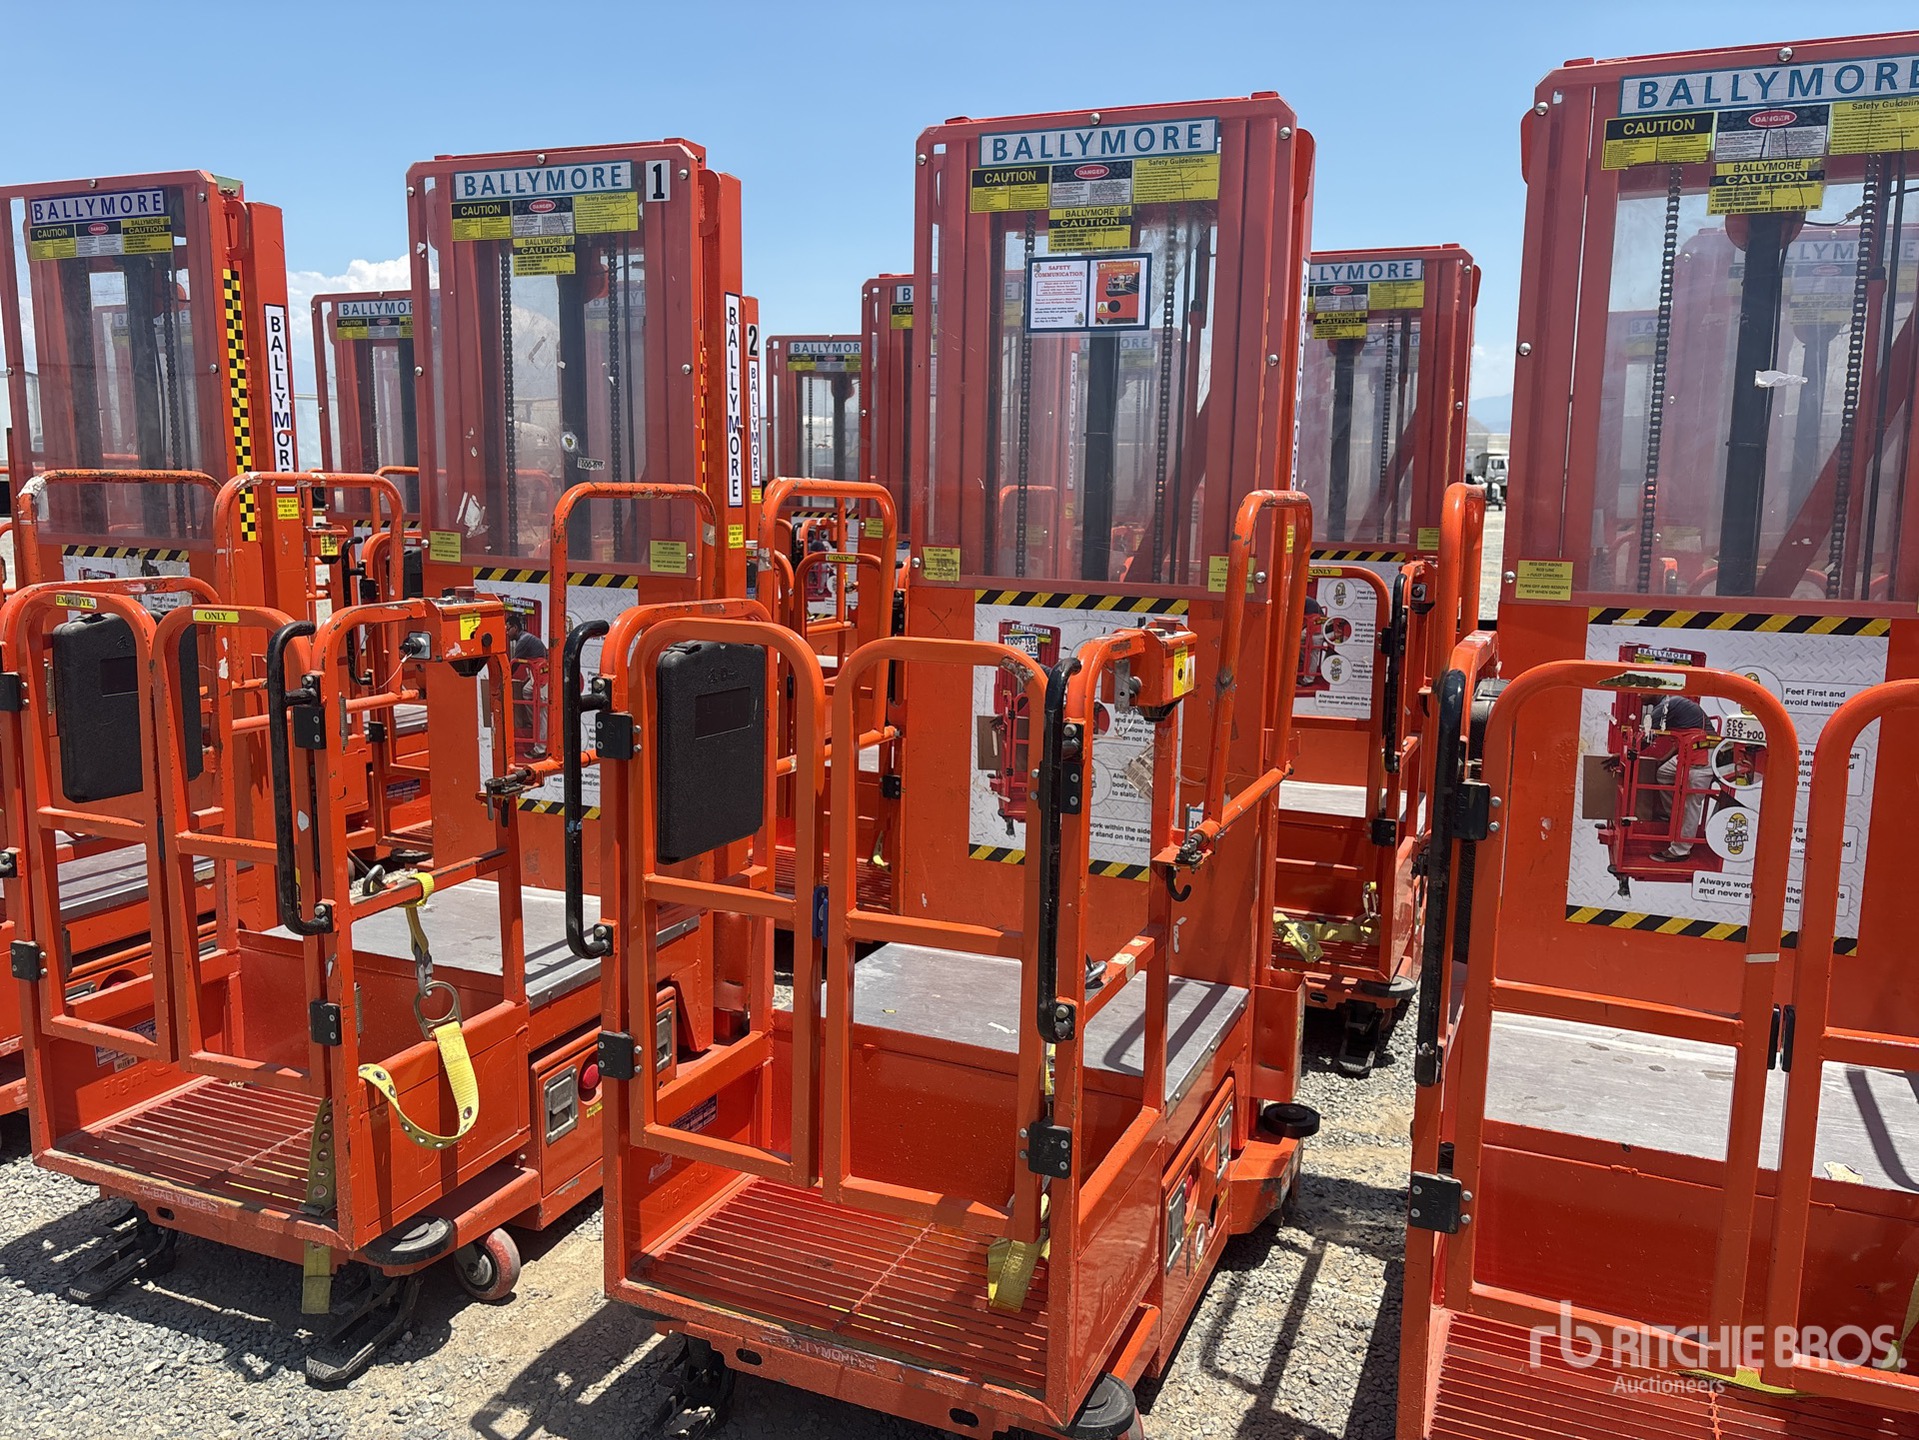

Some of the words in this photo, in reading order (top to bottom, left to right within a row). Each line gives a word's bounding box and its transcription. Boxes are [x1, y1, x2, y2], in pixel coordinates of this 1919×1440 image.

[1851, 101, 1880, 110] Safety
[1754, 114, 1791, 123] DANGER
[1623, 118, 1696, 135] CAUTION
[992, 123, 1202, 162] BALLYMORE
[1148, 158, 1168, 167] Safety
[1733, 161, 1802, 173] BALLYMORE
[984, 170, 1037, 184] CAUTION
[1078, 168, 1106, 176] DANGER
[464, 165, 623, 197] BALLYMORE
[652, 163, 665, 200] 1
[1725, 172, 1808, 185] CAUTION
[33, 193, 162, 221] BALLYMORE
[461, 204, 501, 216] CAUTION
[531, 202, 554, 210] DANGER
[1065, 208, 1115, 218] BALLYMORE
[1060, 217, 1120, 228] CAUTION
[37, 228, 68, 239] CAUTION
[128, 226, 165, 235] CAUTION
[524, 237, 563, 246] BALLYMORE
[521, 246, 567, 255] CAUTION
[749, 325, 758, 356] 2
[270, 316, 291, 472] BALLYMOR
[728, 306, 741, 497] BALLYMORE
[750, 368, 759, 482] BALLYMORE
[204, 612, 227, 621] ONLY
[1640, 648, 1689, 660] BALLYMORE
[1785, 688, 1805, 696] Feet
[1806, 688, 1827, 697] First
[1829, 690, 1846, 698] and
[1112, 781, 1127, 789] body
[1120, 790, 1136, 798] static
[1104, 823, 1124, 831] within
[1125, 825, 1136, 833] the
[1137, 826, 1150, 834] side
[1095, 830, 1114, 839] stand
[1124, 833, 1136, 841] the
[1723, 834, 1749, 843] GEAR
[1699, 876, 1732, 887] Always
[1787, 886, 1802, 894] the
[1717, 890, 1741, 898] never
[1785, 896, 1800, 904] the
[783, 1338, 859, 1365] LLYMORE
